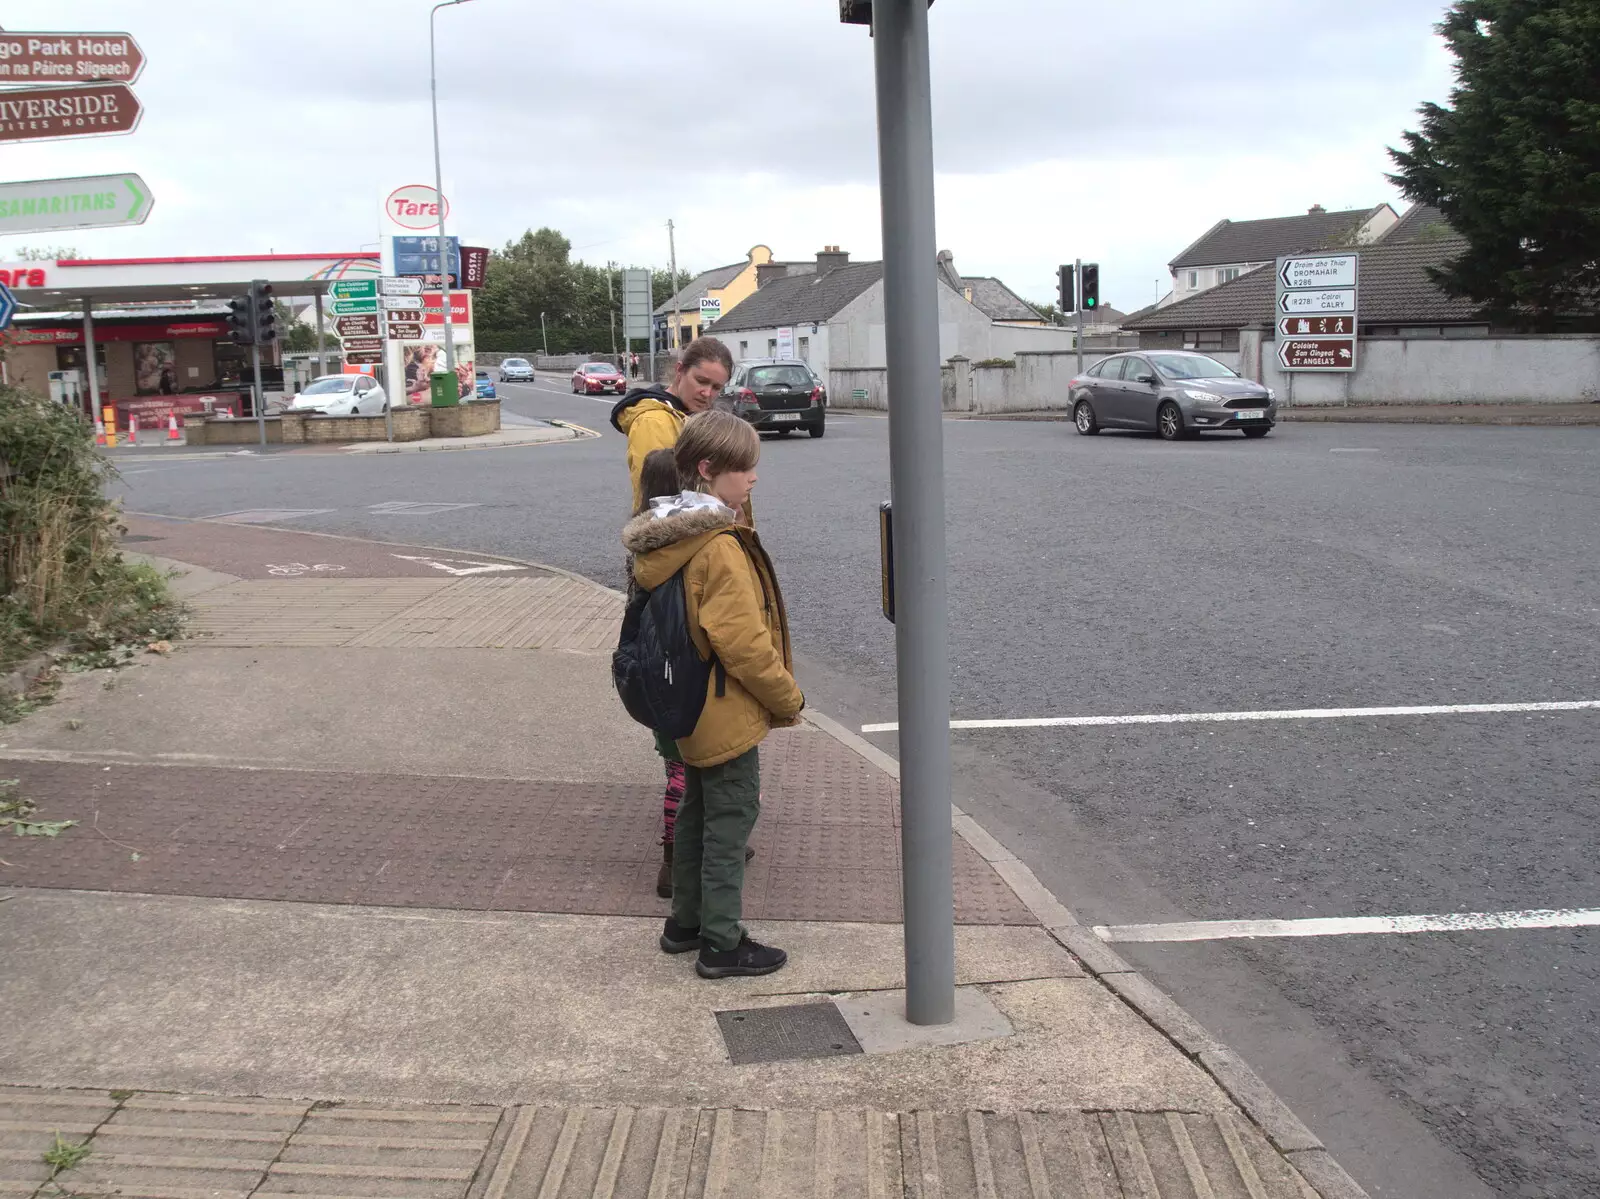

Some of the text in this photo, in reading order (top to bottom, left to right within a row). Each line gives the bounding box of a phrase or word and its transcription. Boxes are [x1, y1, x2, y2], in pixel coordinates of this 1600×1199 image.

[28, 39, 72, 55] Park
[77, 39, 128, 55] Hotel
[13, 64, 29, 75] na
[76, 61, 130, 78] Sligeach
[63, 115, 119, 126] HOTEL
[0, 192, 117, 218] SAMARITANS
[394, 199, 440, 216] Tara
[468, 252, 478, 282] COSTA
[701, 299, 720, 307] DNG
